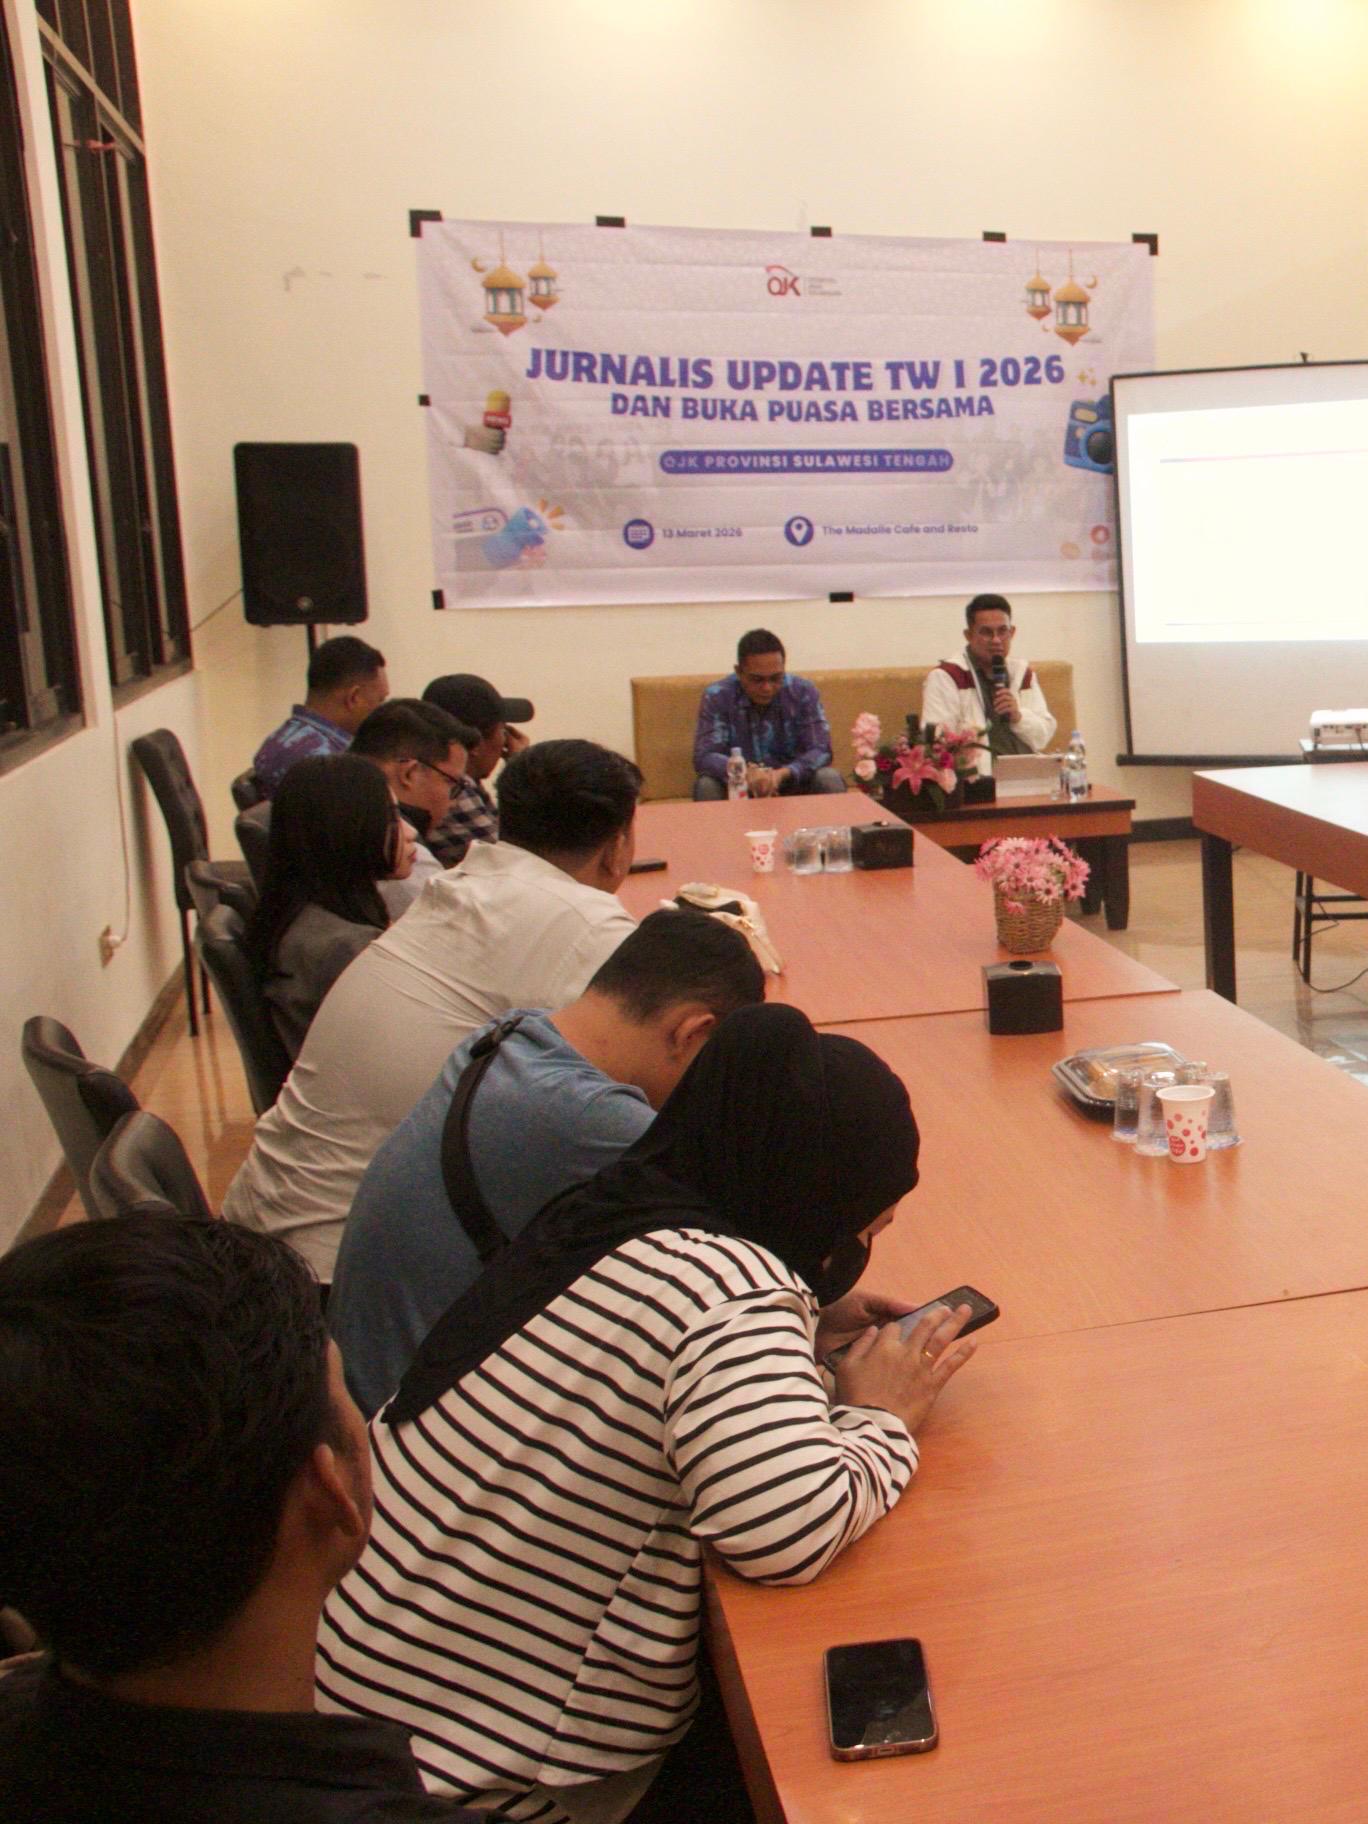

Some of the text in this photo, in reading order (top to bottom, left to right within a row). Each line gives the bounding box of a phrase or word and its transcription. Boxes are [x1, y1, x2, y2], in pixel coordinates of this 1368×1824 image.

[526, 348, 1065, 391] JURNALIS UPDATE TW I 2026
[610, 392, 995, 423] DAN BUKA PUASA BERSAMA
[663, 454, 949, 468] OJK PROVINSI SULAWESI TENGAH
[675, 527, 712, 538] Maret
[714, 526, 743, 538] 2026
[822, 525, 843, 536] The
[894, 523, 921, 534] Cafe
[922, 524, 945, 534] and
[947, 522, 978, 533] Resto
